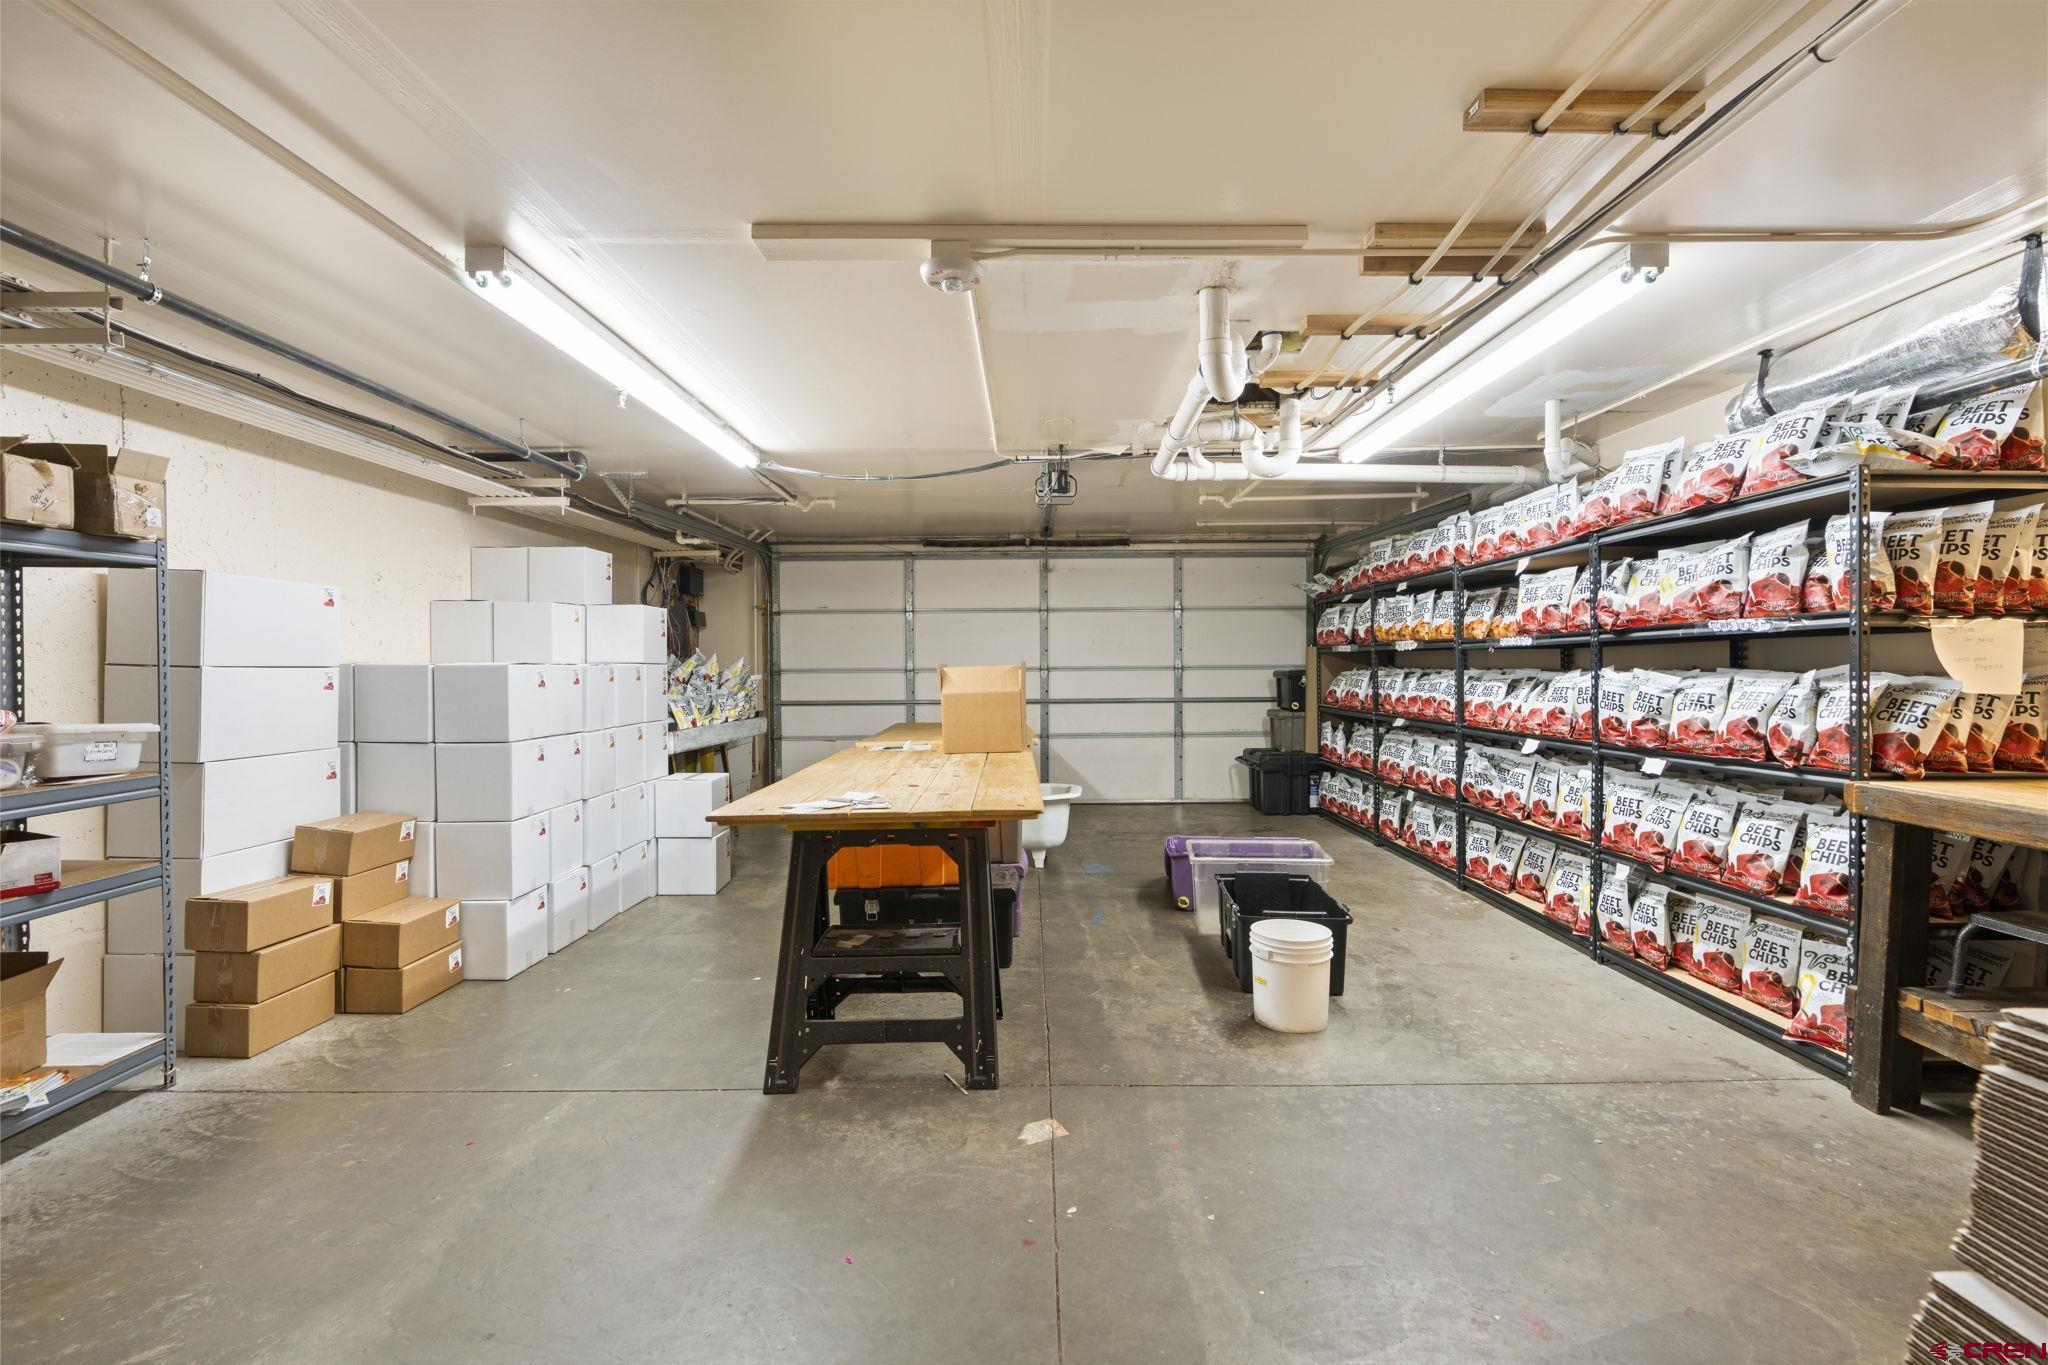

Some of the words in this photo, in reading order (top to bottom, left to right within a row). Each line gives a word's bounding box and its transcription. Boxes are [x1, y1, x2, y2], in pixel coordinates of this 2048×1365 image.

[1961, 400, 2014, 417] BEET
[1774, 417, 1813, 433] BEET
[1876, 413, 1898, 425] ET
[1951, 413, 2007, 426] CHIPS
[1766, 429, 1808, 444] CHIPS
[1715, 439, 1750, 453] BEET
[1707, 450, 1744, 462] CHIPS
[1626, 464, 1655, 475] BEET
[1620, 475, 1652, 484] CHIPS
[1527, 502, 1551, 513] BEET
[1944, 529, 1974, 543] ET
[1983, 535, 2006, 547] ET
[1755, 545, 1792, 561] BEET
[1939, 543, 1971, 556] IPS
[1705, 552, 1734, 568] BEET
[1750, 556, 1790, 571] CHIPS
[1645, 569, 1660, 578] BE
[1700, 564, 1734, 577] CHIPS
[1675, 574, 1698, 586] CHI
[1546, 585, 1566, 593] BEET
[1521, 595, 1539, 604] CHIP
[1541, 593, 1564, 601] CHIPS
[1477, 691, 1500, 699] CHIPS
[1482, 684, 1502, 693] BEET
[1552, 686, 1570, 695] BEET
[1547, 695, 1569, 703] CHIPS
[1602, 690, 1625, 701] BEET
[1637, 691, 1665, 706] BEET
[1682, 692, 1717, 704] BEET
[1740, 691, 1774, 702] BEET
[1826, 696, 1850, 708] BEE
[1976, 694, 2001, 708] ET
[2014, 691, 2041, 704] ET
[1600, 700, 1625, 713] CHIPS
[1632, 701, 1663, 716] CHIPS
[1677, 702, 1716, 714] CHIPS
[1730, 701, 1767, 713] CHIPS
[1886, 698, 1937, 716] BEET
[2010, 705, 2040, 717] IPS
[1819, 708, 1850, 720] CHIP
[1876, 710, 1930, 729] CHIPS
[1438, 767, 1456, 775] CHIPS
[1509, 771, 1526, 780] BEET
[1506, 779, 1524, 790] CHIPS
[1536, 777, 1552, 787] BEET
[1533, 785, 1551, 797] CHIPS
[1568, 785, 1580, 795] BE
[1616, 795, 1643, 810] BEET
[1612, 805, 1642, 819] CHIPS
[1652, 805, 1675, 820] BEET
[1645, 813, 1671, 829] CHIPS
[1690, 810, 1723, 828] BEET
[1414, 828, 1431, 837] CHIPS
[1684, 820, 1720, 838] CHIPS
[1746, 822, 1785, 840] BEET
[1471, 836, 1489, 846] BEET
[1740, 832, 1782, 851] CHIPS
[1816, 838, 1848, 854] BEE
[1930, 839, 1954, 855] ET
[1973, 837, 2001, 855] ET
[1468, 844, 1490, 854] CHIPS
[1500, 845, 1515, 855] BEET
[1495, 852, 1512, 863] CHIPS
[1527, 851, 1547, 861] BEET
[1810, 849, 1848, 865] CHIP
[1523, 858, 1545, 873] CHIPS
[1560, 869, 1583, 883] BEET
[1556, 879, 1580, 892] CHIPS
[1601, 893, 1622, 908] BEET
[1599, 904, 1624, 918] CHIPS
[1636, 902, 1659, 917] BEET
[1632, 911, 1658, 927] CHIPS
[1673, 911, 1697, 926] BEE
[1705, 919, 1740, 938] BEET
[1701, 930, 1738, 949] CHIPS
[1753, 937, 1790, 958] BEET
[1748, 948, 1789, 969] CHIPS
[1826, 968, 1848, 983] BE
[1964, 961, 1993, 984] ET
